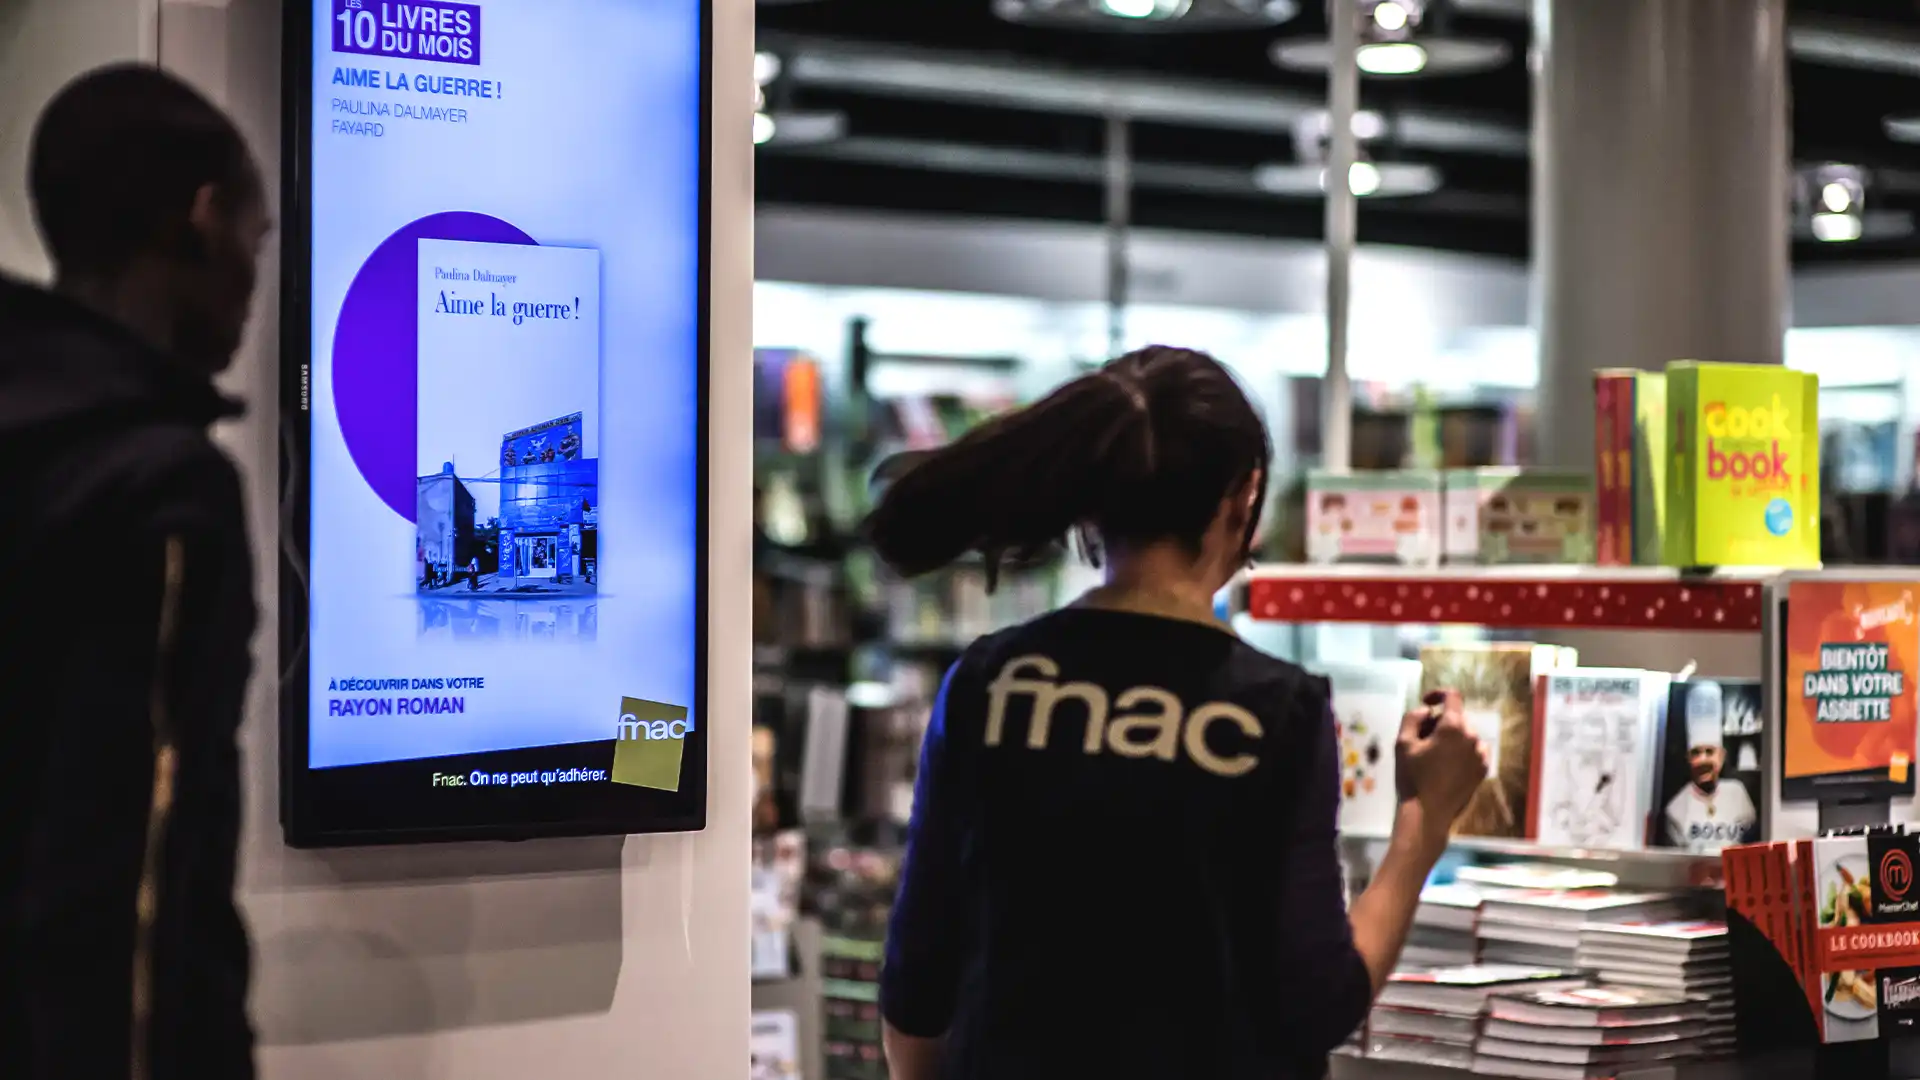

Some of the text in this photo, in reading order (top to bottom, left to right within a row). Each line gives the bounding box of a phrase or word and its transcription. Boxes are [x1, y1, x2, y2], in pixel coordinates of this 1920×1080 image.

[345, 0, 362, 8] LES
[336, 9, 376, 49] 10
[381, 2, 472, 35] LIVRES
[381, 29, 473, 59] DU MOIS
[332, 67, 381, 88] AIME
[386, 71, 409, 91] LA
[414, 74, 492, 98] GUERRE
[332, 98, 467, 123] PAULINA DALMAYER
[332, 119, 384, 137] FAYARD
[435, 266, 517, 287] Paulina Dalmayer
[435, 290, 484, 315] Aime
[491, 292, 506, 316] la
[1705, 393, 1791, 439] cook
[1707, 436, 1789, 482] book
[1821, 644, 1889, 670] BIENTÔT
[328, 676, 485, 691] À DÉCOUVRIR DANS VOTRE
[1804, 672, 1904, 696] DANS VOTRE
[328, 696, 465, 717] RAYON ROMAN
[984, 653, 1264, 777] fnac
[1817, 698, 1891, 721] ASSIETTE
[618, 713, 687, 741] fnac
[432, 766, 607, 787] Fnac. On ne peut qu'adhérer.
[1829, 929, 1920, 952] LE COOKBOOK
